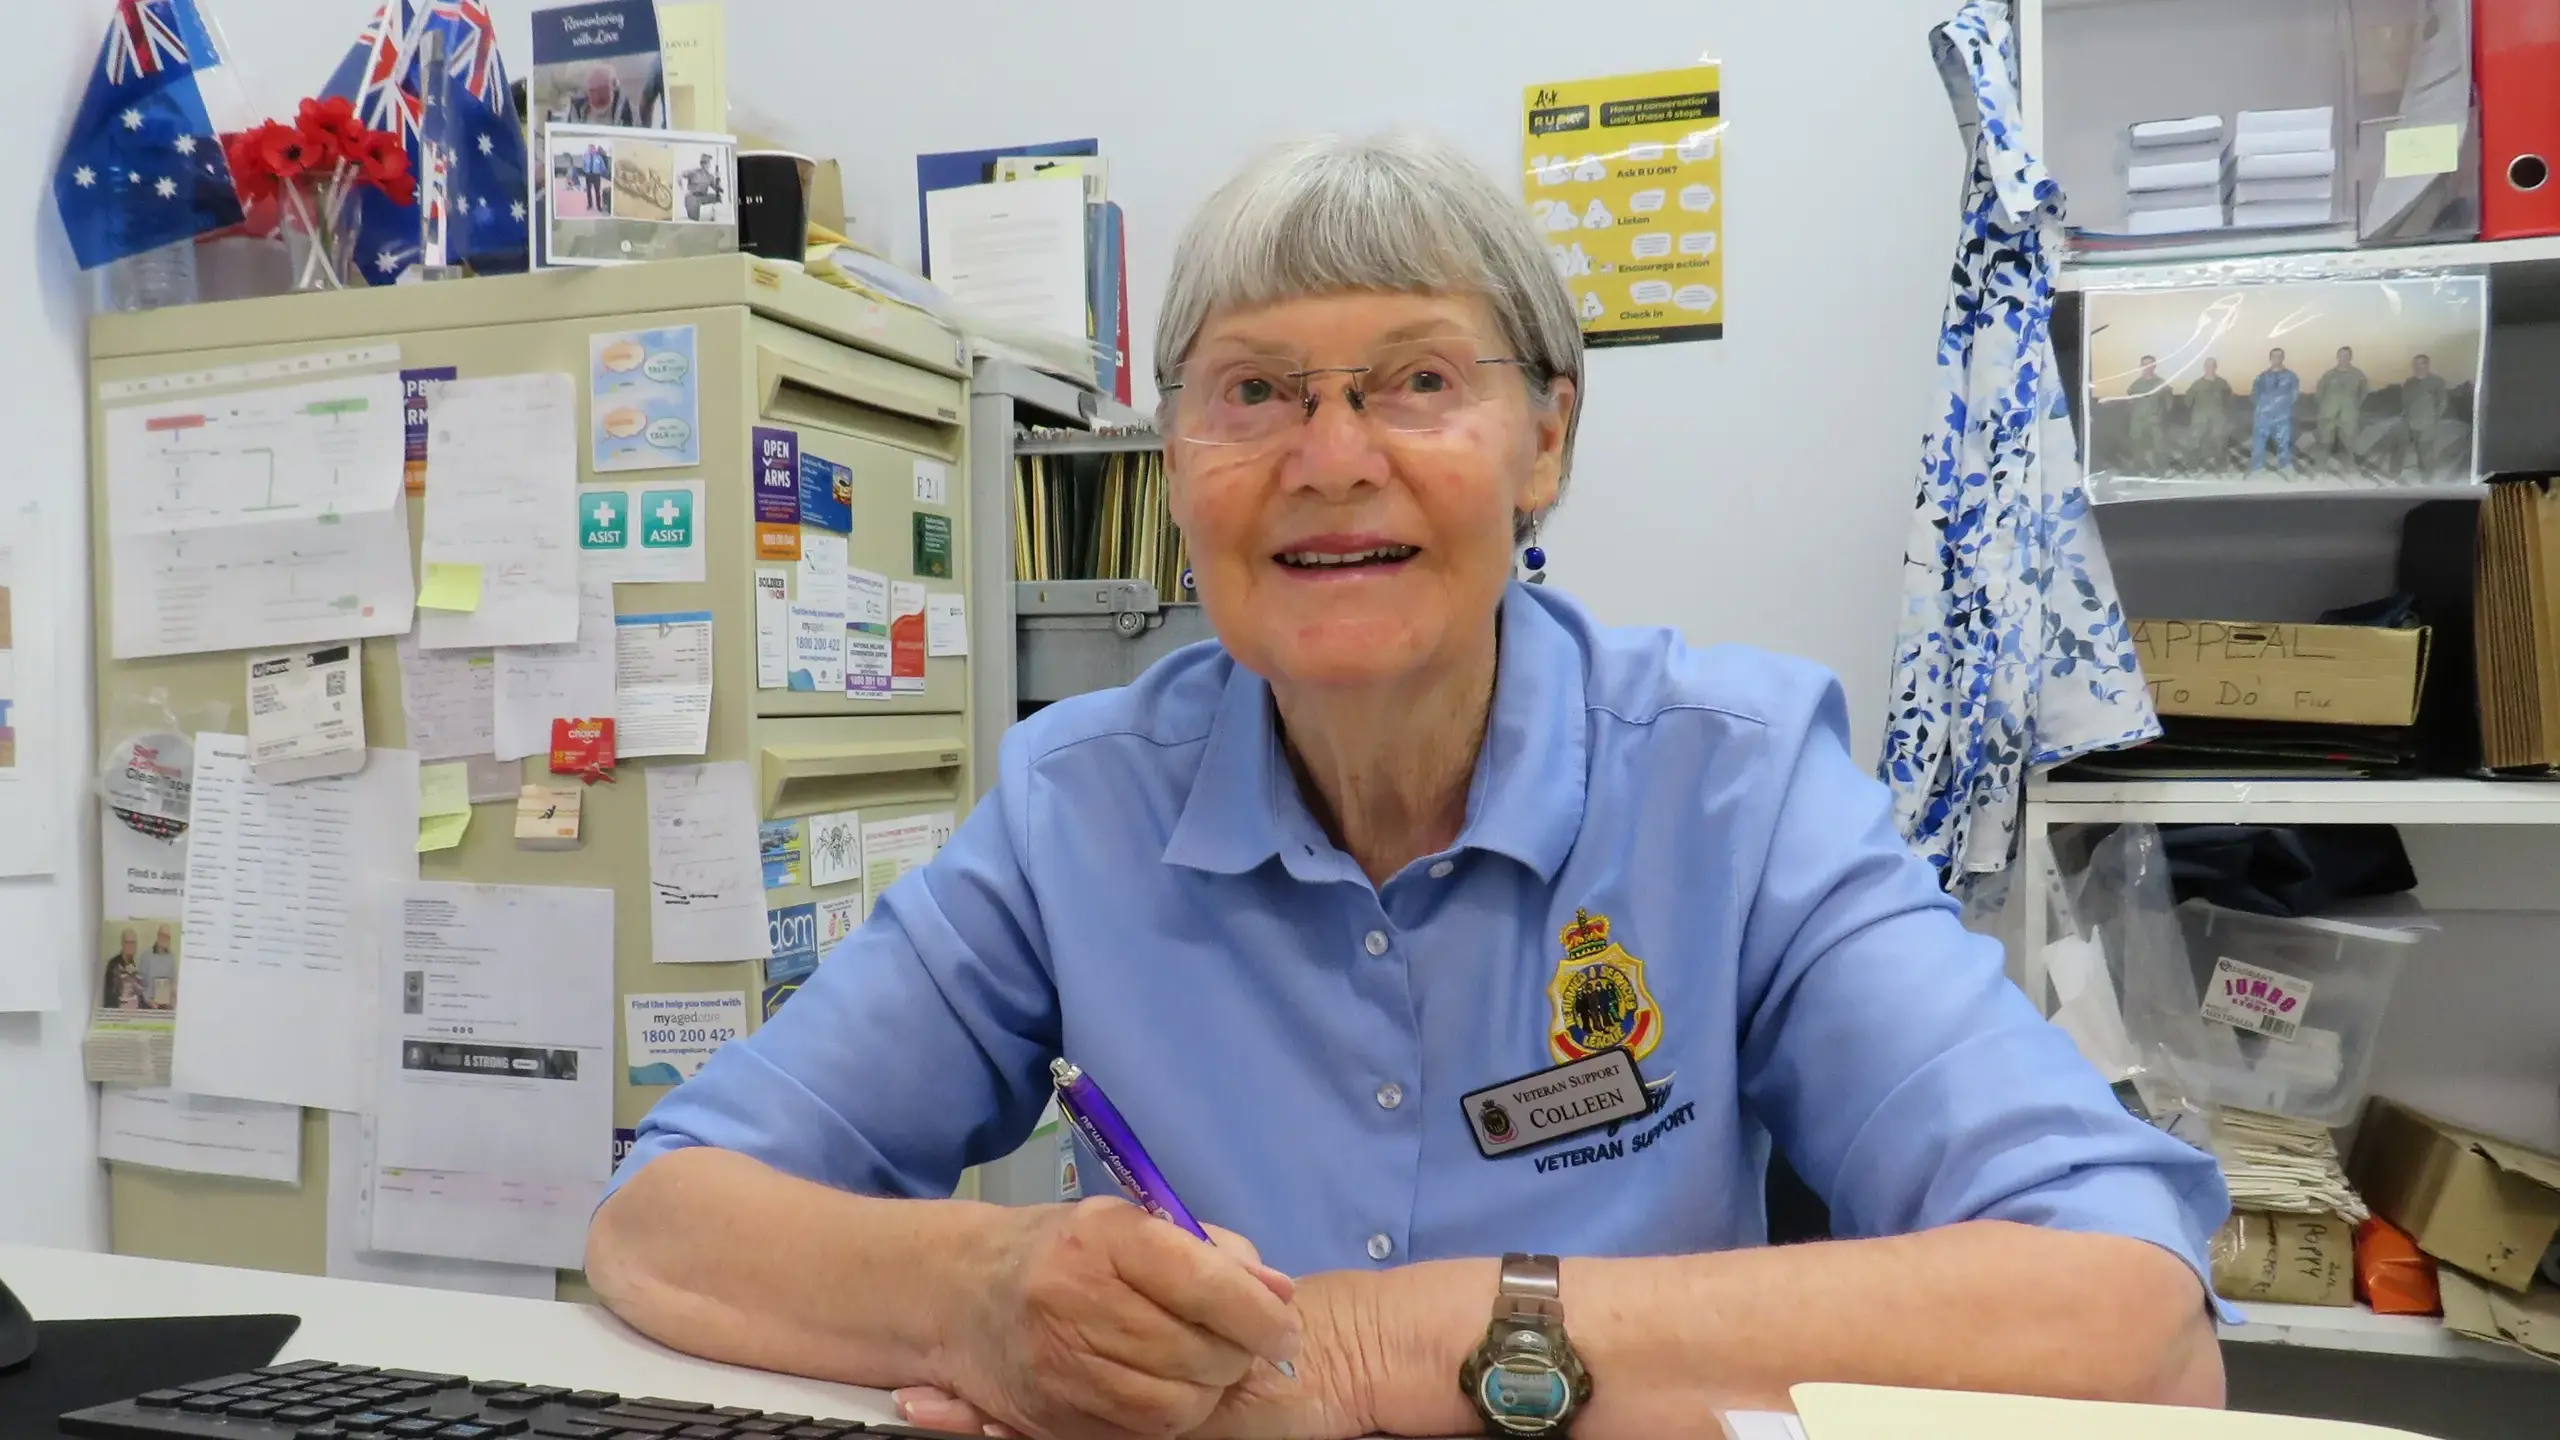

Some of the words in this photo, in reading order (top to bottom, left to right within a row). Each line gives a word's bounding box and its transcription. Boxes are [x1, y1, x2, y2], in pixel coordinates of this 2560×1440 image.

[562, 12, 624, 33] Remembering
[572, 33, 592, 46] with
[594, 29, 619, 44] Love
[1534, 89, 1559, 107] Ask
[1610, 104, 1635, 115] Have
[1643, 97, 1708, 111] conversation
[1534, 115, 1544, 127] R
[1610, 115, 1635, 125] using
[1637, 111, 1665, 122] these
[1666, 111, 1673, 120] 4
[1674, 109, 1701, 121] steps
[1617, 169, 1636, 178] Ask
[1657, 166, 1678, 176] OK?
[1617, 216, 1650, 226] Listen
[1618, 263, 1673, 274] Encourage
[1675, 259, 1710, 270] action
[1619, 310, 1650, 320] Check
[1653, 310, 1663, 318] in
[763, 439, 789, 459] OPEN
[764, 469, 791, 488] ARMS
[588, 530, 621, 543] ASIST
[650, 529, 685, 541] ASIST
[796, 636, 812, 650] 1800
[815, 637, 827, 650] 200
[828, 639, 840, 652] 422
[2131, 620, 2336, 662] APPEAL
[2146, 679, 2189, 706] To
[126, 767, 158, 784] Clear
[162, 777, 191, 791] Tape
[127, 868, 148, 879] Find
[128, 883, 178, 896] Document
[769, 911, 815, 951] dcm
[1600, 965, 1638, 1010] SERVICES
[2225, 978, 2297, 1012] JUMBO
[632, 1001, 649, 1009] Find
[666, 1000, 683, 1010] help
[684, 1001, 700, 1010] you
[701, 999, 720, 1007] need
[722, 998, 741, 1007] with
[653, 1011, 721, 1026] myagedcare
[2205, 1009, 2254, 1028] AUSTRALIA
[642, 1030, 675, 1043] 1800
[680, 1029, 705, 1043] 200
[473, 1055, 509, 1069] STRONG
[1534, 1139, 1624, 1174] VETERAN
[1632, 1101, 1696, 1153] SUPPORT
[1080, 1115, 1149, 1198] yourplay.com.au
